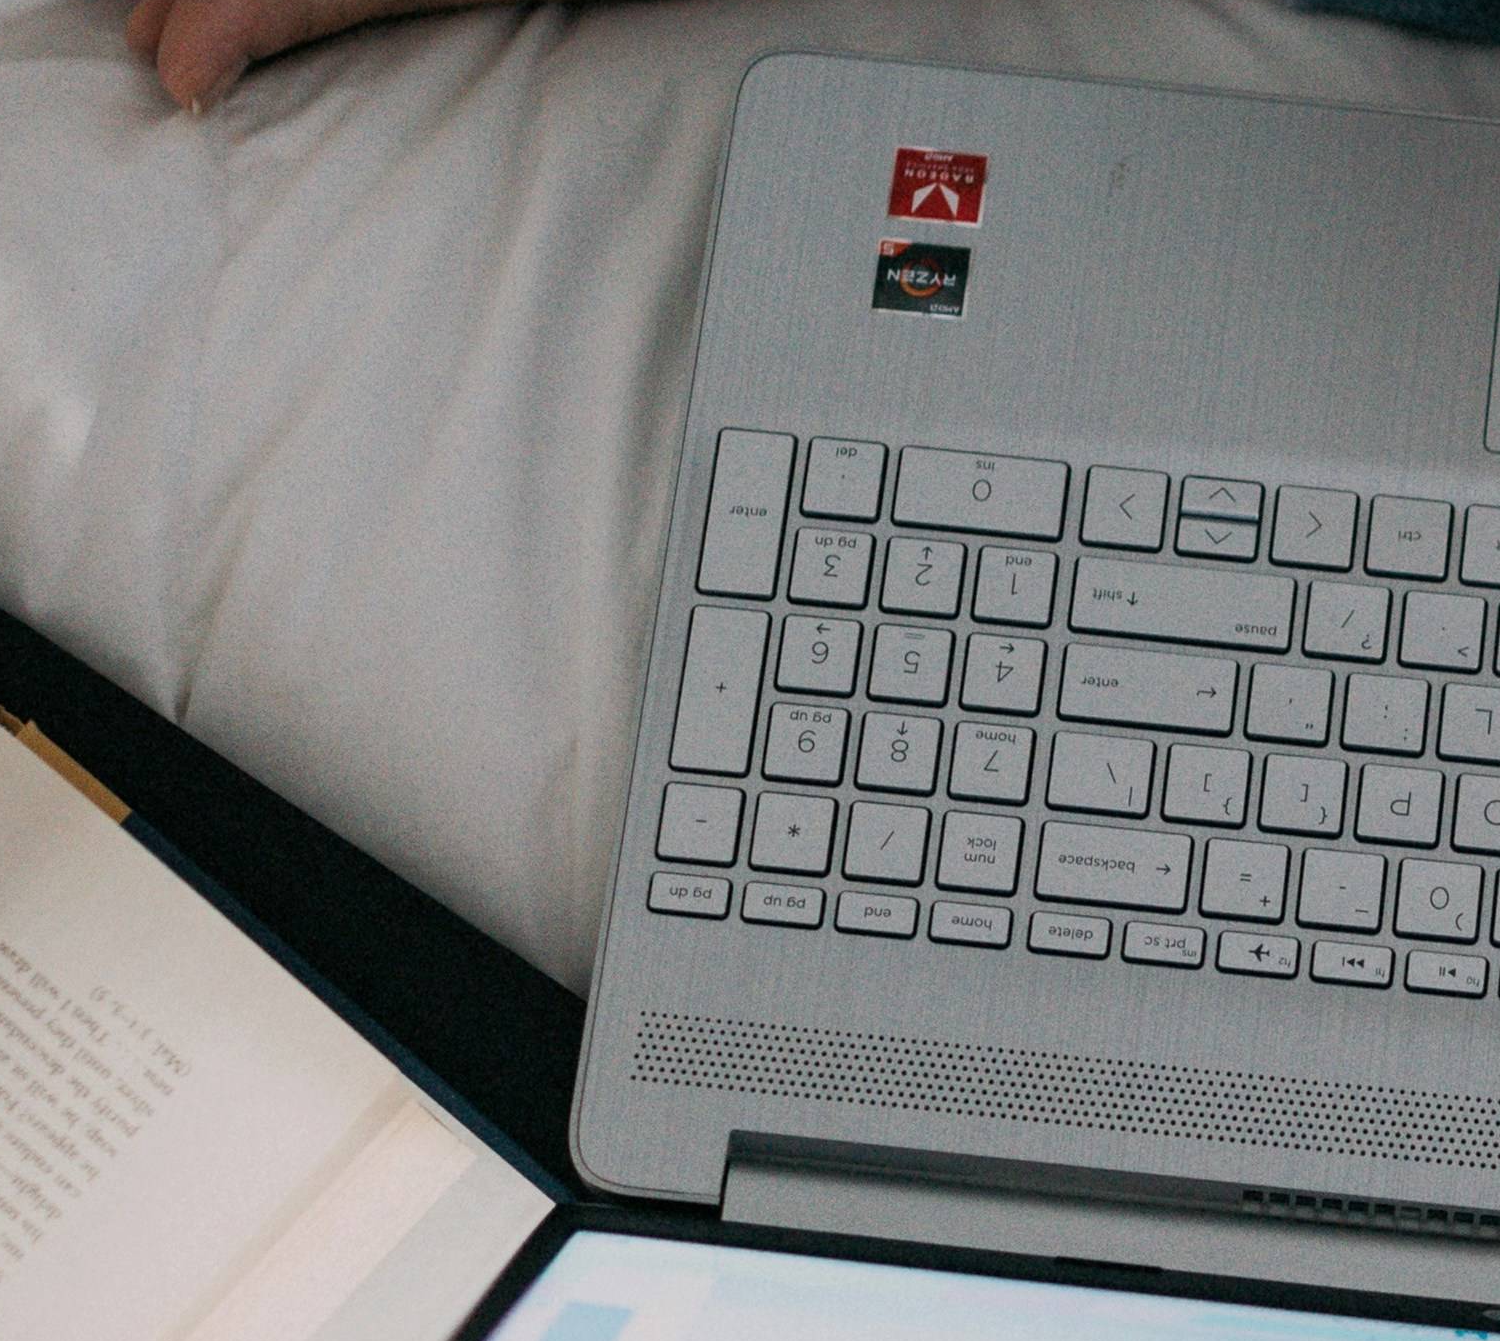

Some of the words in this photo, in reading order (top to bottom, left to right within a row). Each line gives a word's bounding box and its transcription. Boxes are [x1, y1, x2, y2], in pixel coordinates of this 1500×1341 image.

[885, 266, 956, 287] RYZEN
[727, 502, 768, 520] enter
[1089, 585, 1123, 604] shift
[1232, 619, 1278, 638] pause
[1078, 673, 1120, 690] enter
[964, 833, 997, 851] lock
[962, 850, 997, 865] num
[1055, 850, 1136, 874] backspace
[666, 884, 691, 900] dn
[693, 884, 713, 901] pg
[761, 891, 784, 908] up
[786, 893, 807, 910] pg
[861, 903, 893, 921] end
[949, 913, 994, 931] home
[1046, 923, 1095, 942] delete
